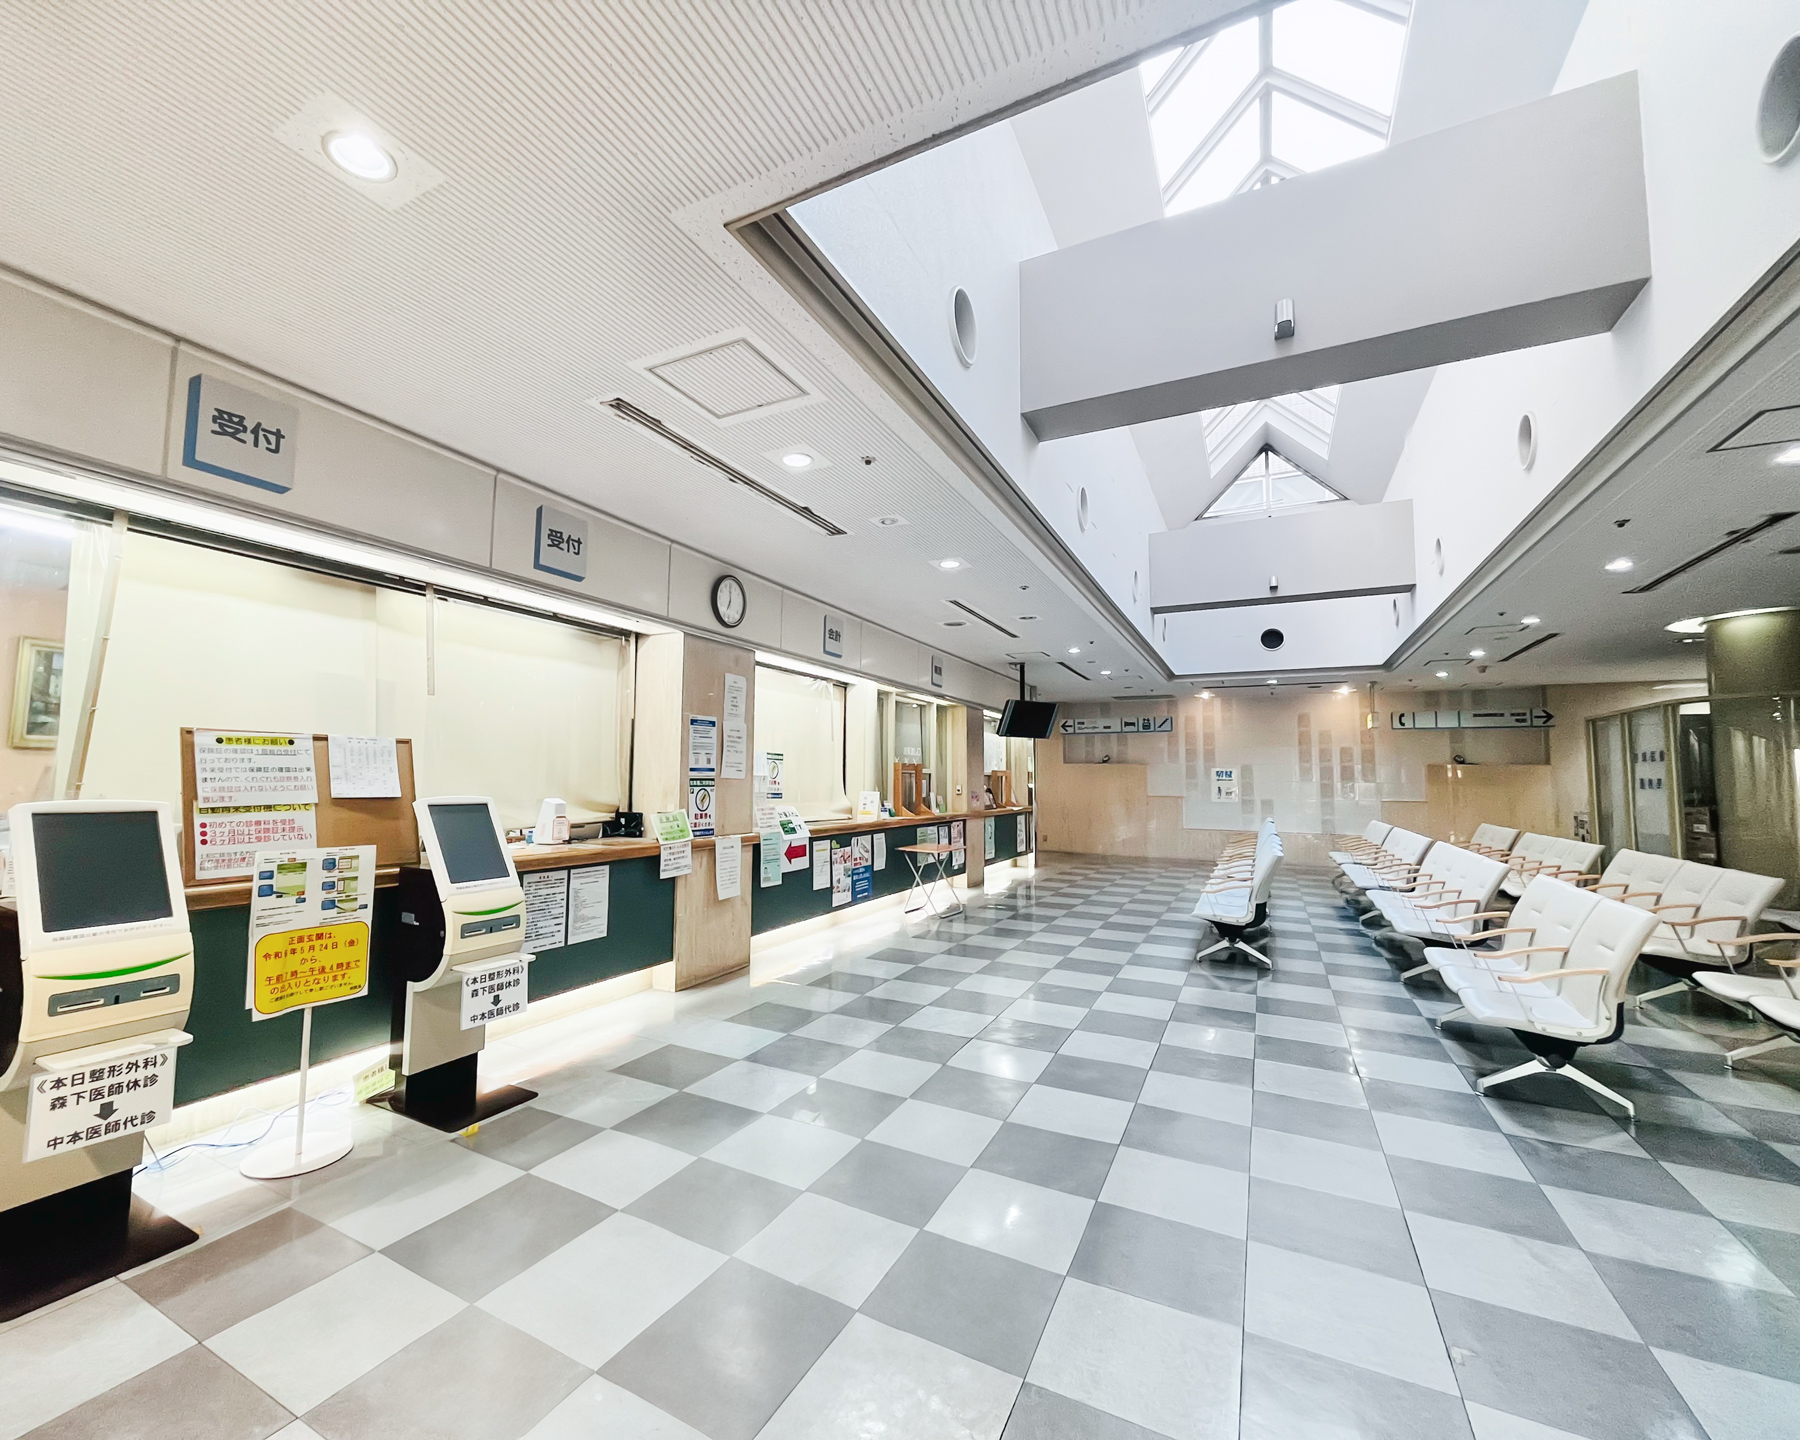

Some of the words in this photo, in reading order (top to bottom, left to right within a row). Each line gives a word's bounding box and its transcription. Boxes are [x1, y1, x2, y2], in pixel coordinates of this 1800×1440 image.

[211, 408, 286, 454] 受付
[547, 528, 583, 556] 受付
[828, 628, 841, 643] 会計
[471, 978, 520, 998] 森下医師休診
[470, 1003, 520, 1023] 中本医師代診
[49, 1073, 160, 1111] 森下医師休診
[46, 1110, 156, 1151] 中本医師代診
